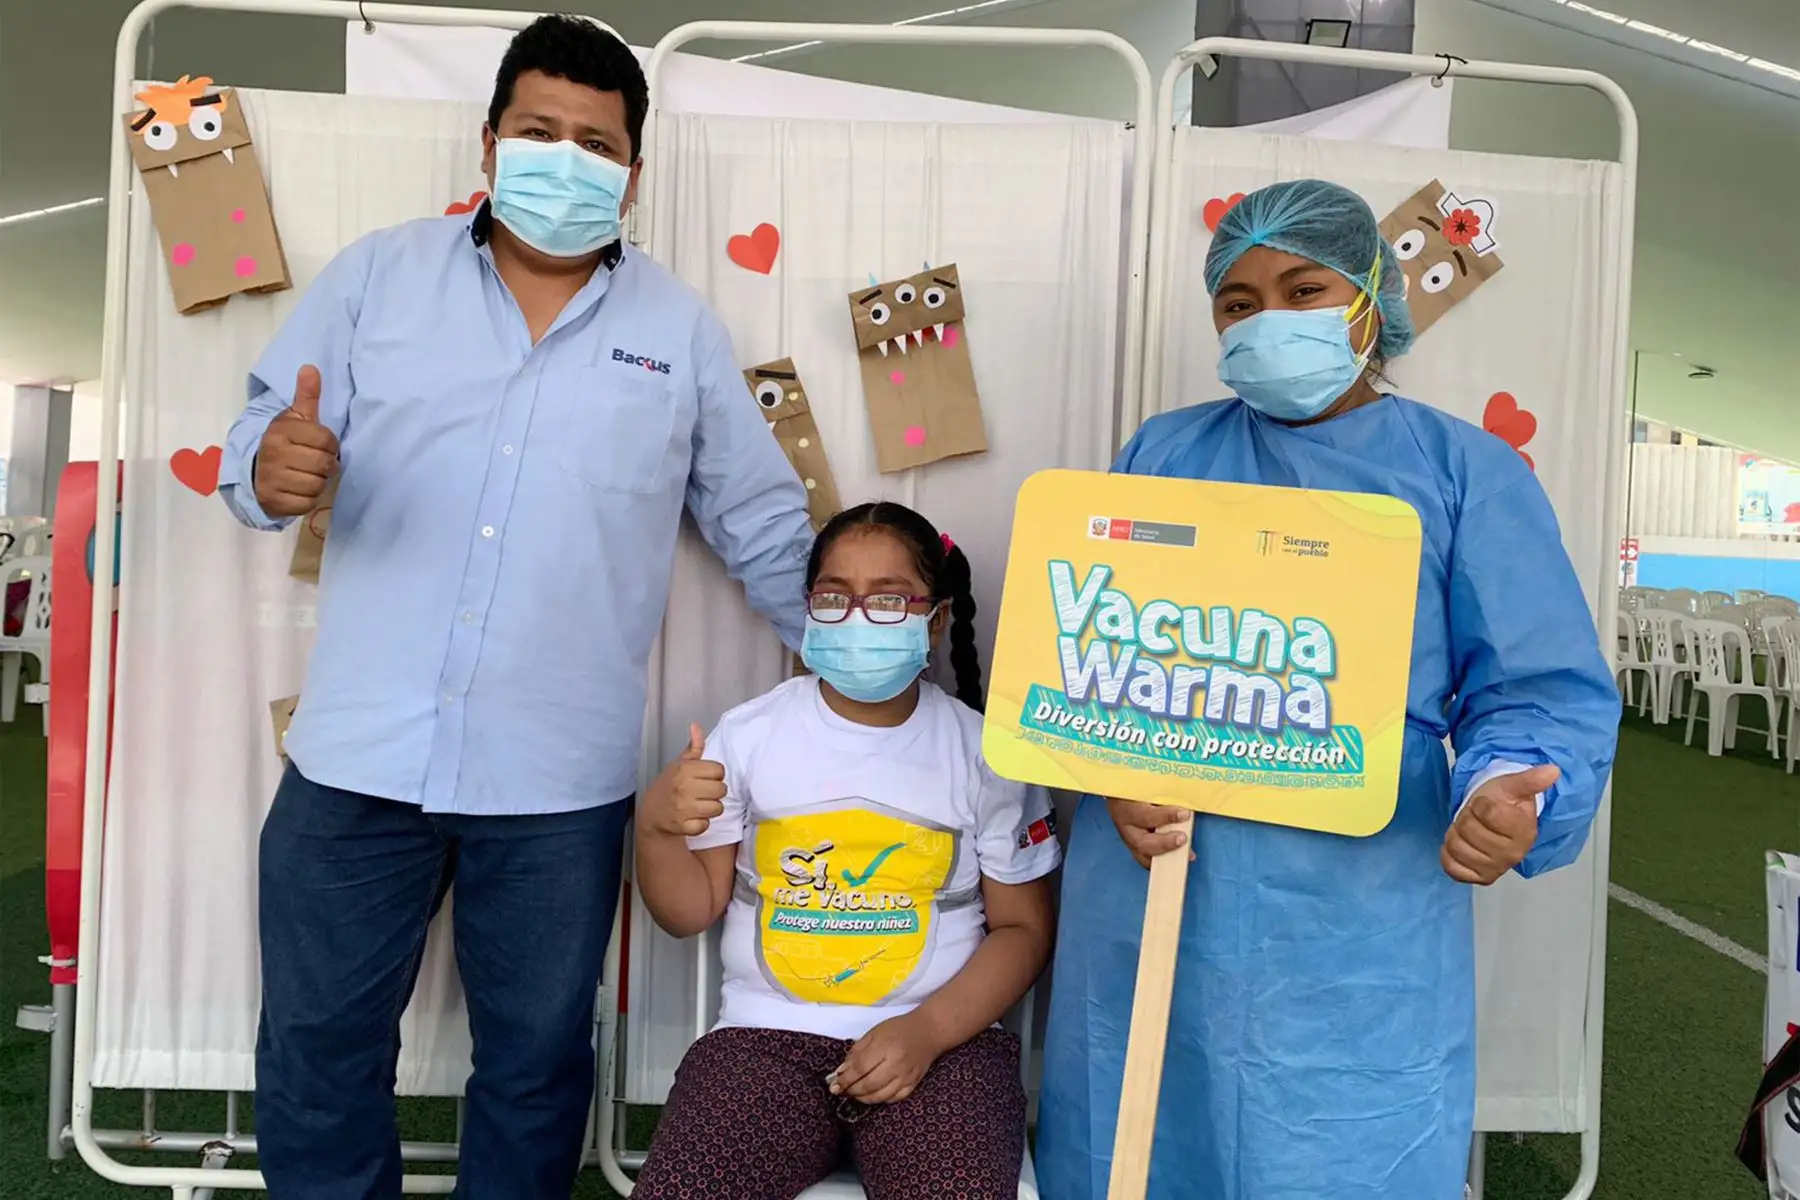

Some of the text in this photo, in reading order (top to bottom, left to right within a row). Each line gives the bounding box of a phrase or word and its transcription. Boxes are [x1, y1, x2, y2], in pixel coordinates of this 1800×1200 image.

[1283, 535, 1330, 549] Siempre
[1048, 559, 1335, 677] Vacuna
[1057, 634, 1331, 734] Warma
[1033, 700, 1348, 766] Diversión con protección
[773, 888, 811, 907] me
[774, 911, 913, 933] Protege nuestra niñez
